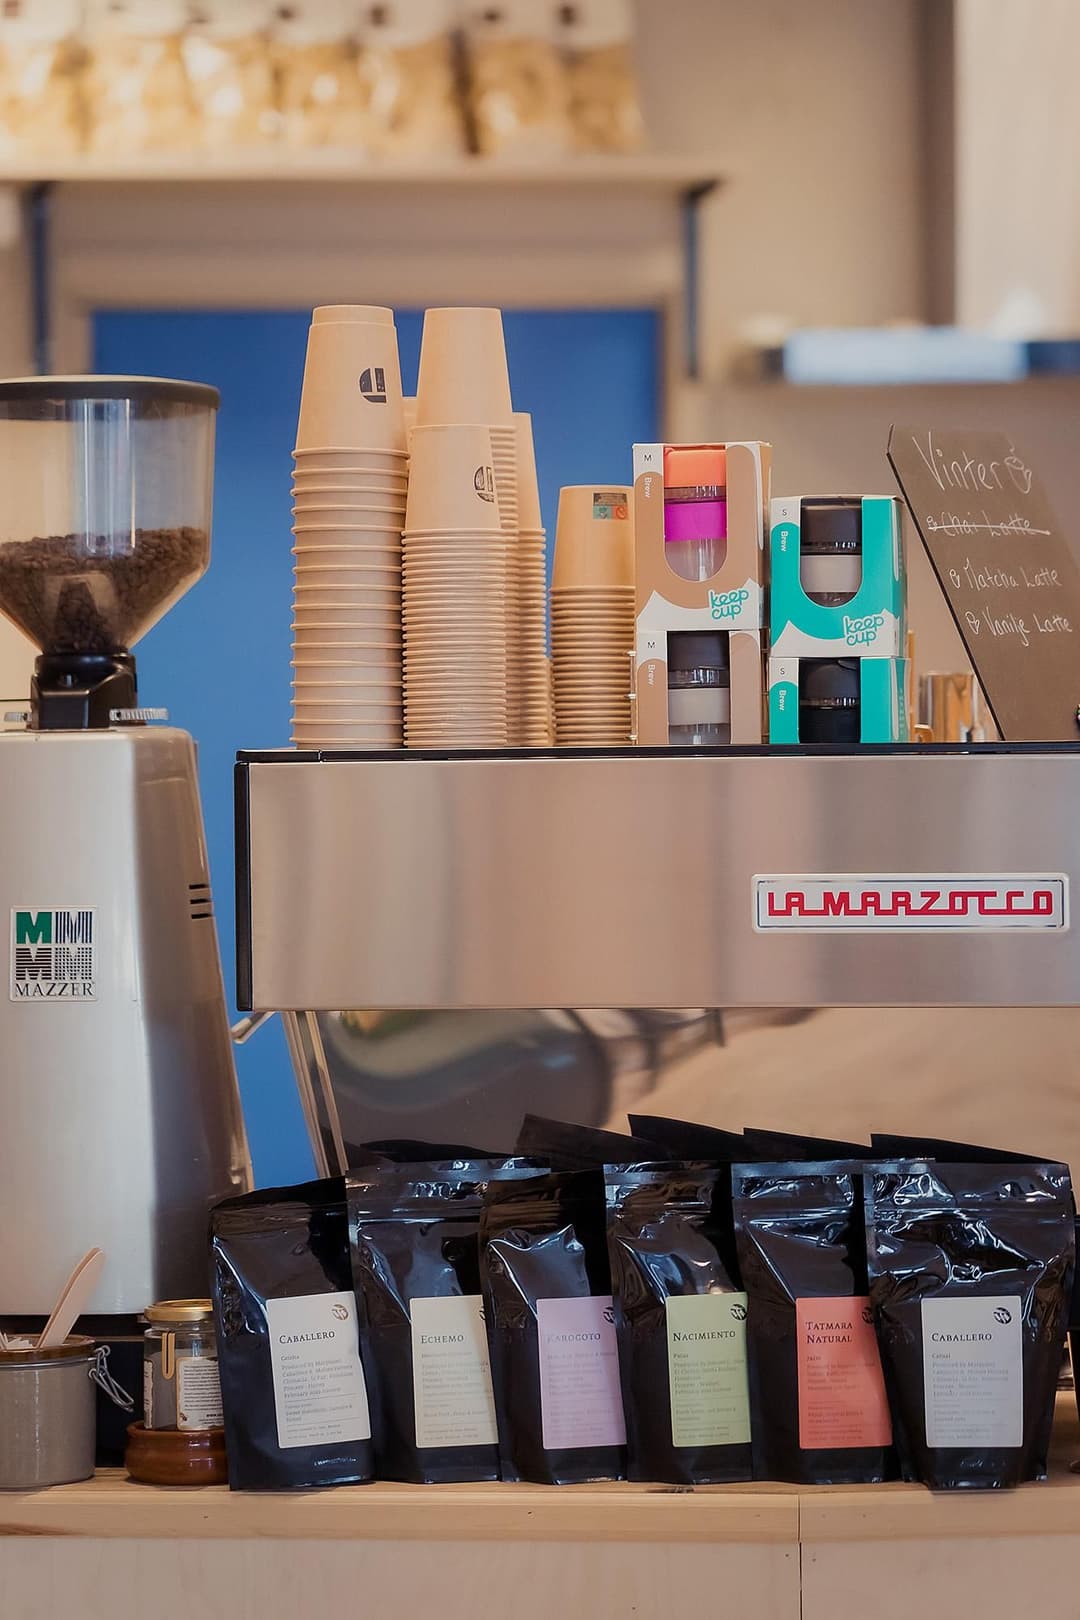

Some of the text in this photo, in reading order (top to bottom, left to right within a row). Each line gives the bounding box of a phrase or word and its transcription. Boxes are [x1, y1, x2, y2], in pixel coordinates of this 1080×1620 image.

[643, 454, 653, 462] M
[911, 431, 1003, 491] Vinter
[645, 476, 653, 498] Brew
[782, 508, 788, 517] S
[780, 530, 789, 552] Brew
[709, 589, 750, 608] keep
[711, 603, 743, 620] cup
[844, 616, 884, 634] keep
[647, 641, 656, 649] M
[846, 630, 877, 647] cup
[648, 664, 656, 687] Brew
[780, 667, 786, 676] S
[778, 689, 787, 712] Brew
[15, 982, 94, 997] MAZZER
[805, 1320, 853, 1331] TATMARA
[279, 1330, 336, 1344] CABALLERO
[420, 1334, 465, 1344] ECHEMO
[672, 1330, 736, 1342] NACIMIENTO
[806, 1334, 853, 1344] NATURAL
[931, 1332, 992, 1342] CABALLERO
